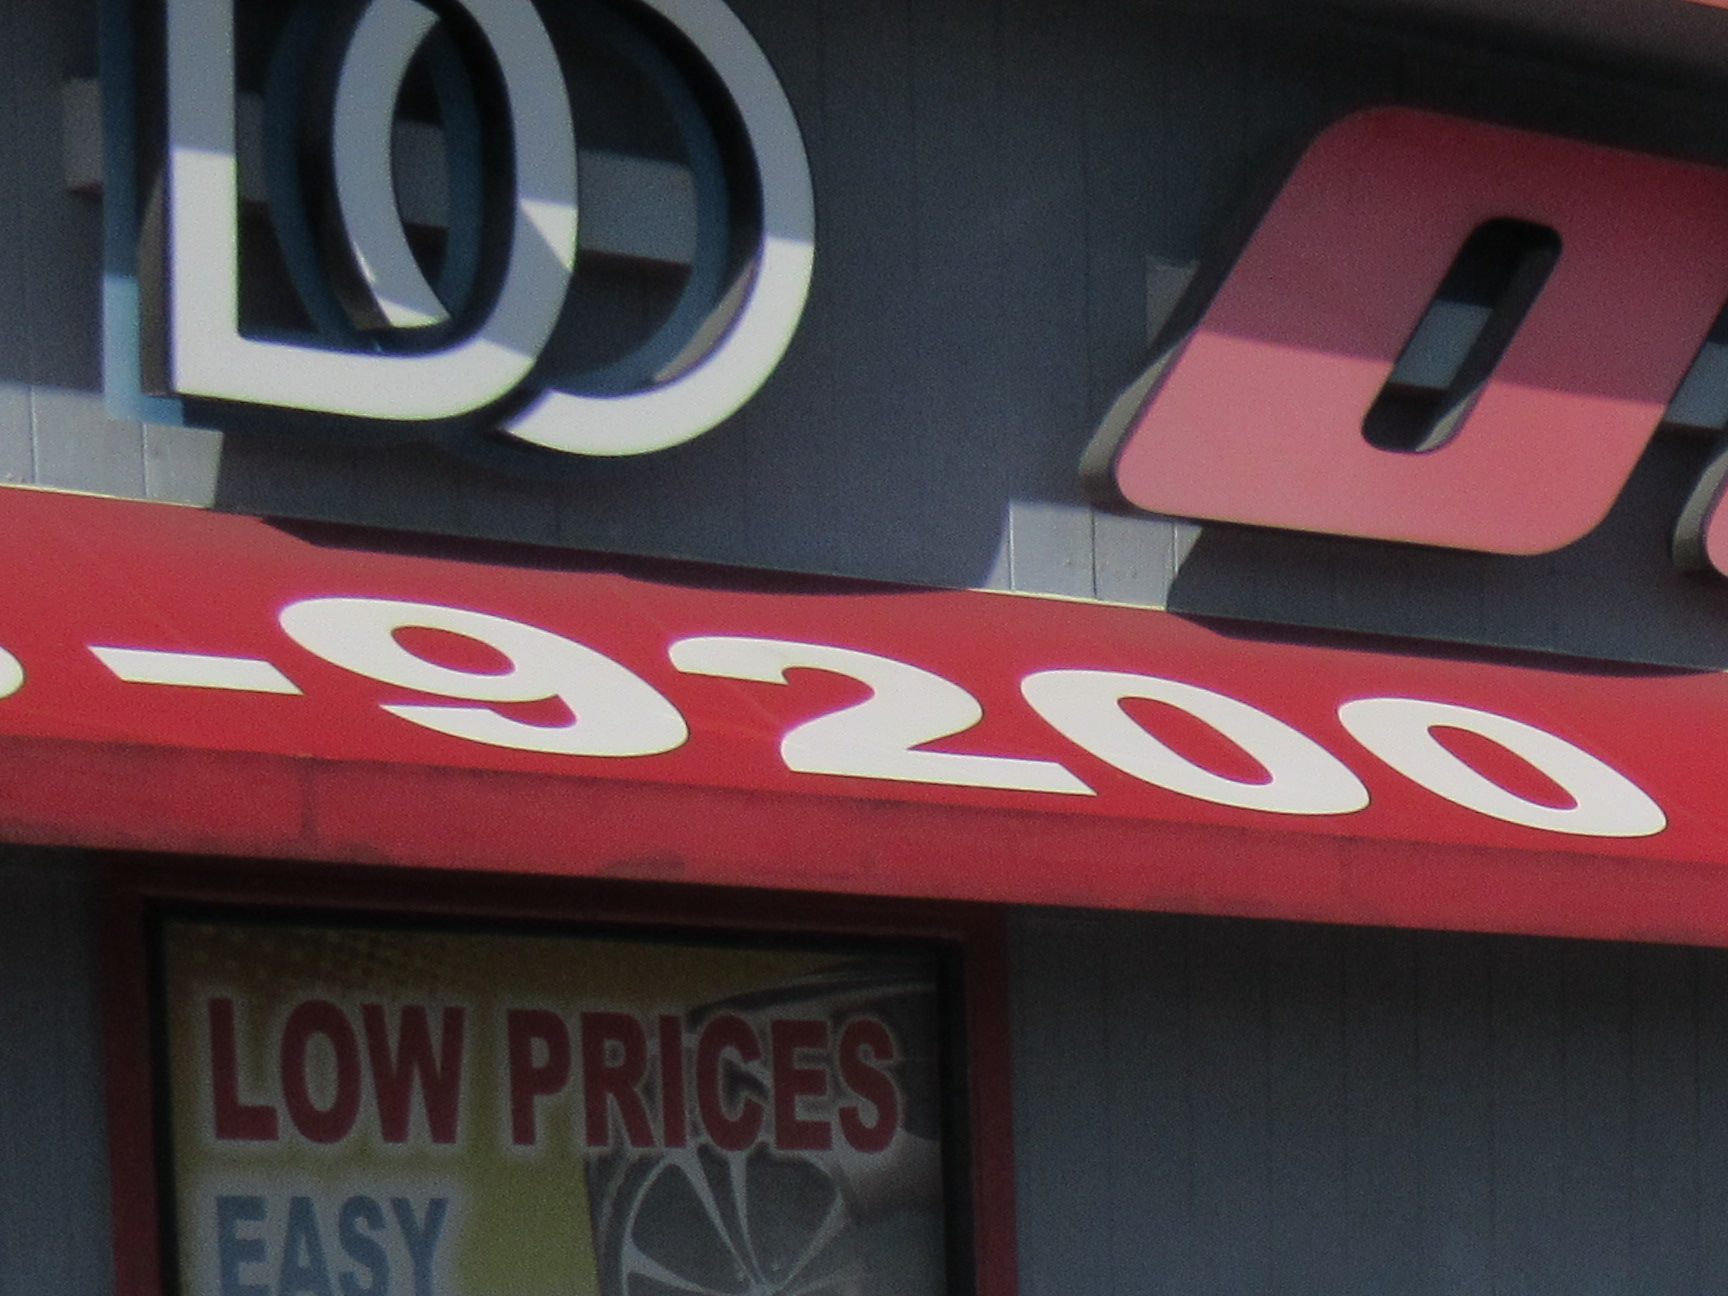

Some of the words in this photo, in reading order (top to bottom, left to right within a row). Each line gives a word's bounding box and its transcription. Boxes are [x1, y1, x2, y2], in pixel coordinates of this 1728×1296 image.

[0, 596, 1667, 837] -9200
[208, 998, 465, 1147] LOW
[506, 1008, 903, 1156] PRICES
